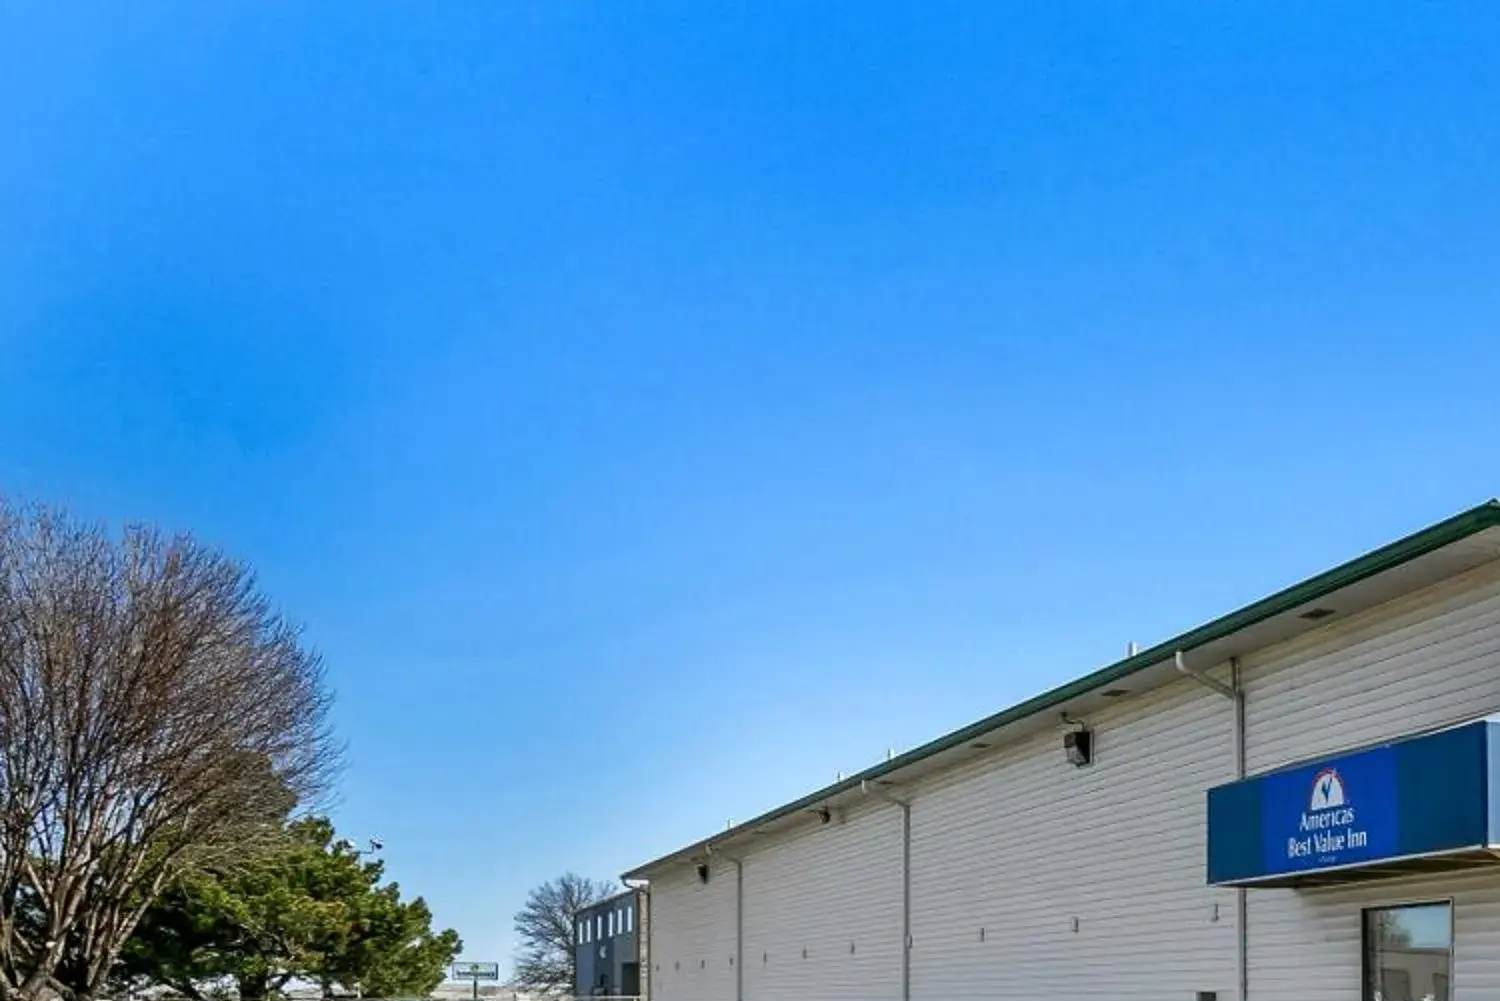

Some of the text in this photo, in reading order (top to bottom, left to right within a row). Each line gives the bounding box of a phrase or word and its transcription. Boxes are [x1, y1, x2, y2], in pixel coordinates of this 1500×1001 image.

[1299, 807, 1355, 832] Americas
[1287, 827, 1368, 859] Best Value Inn
